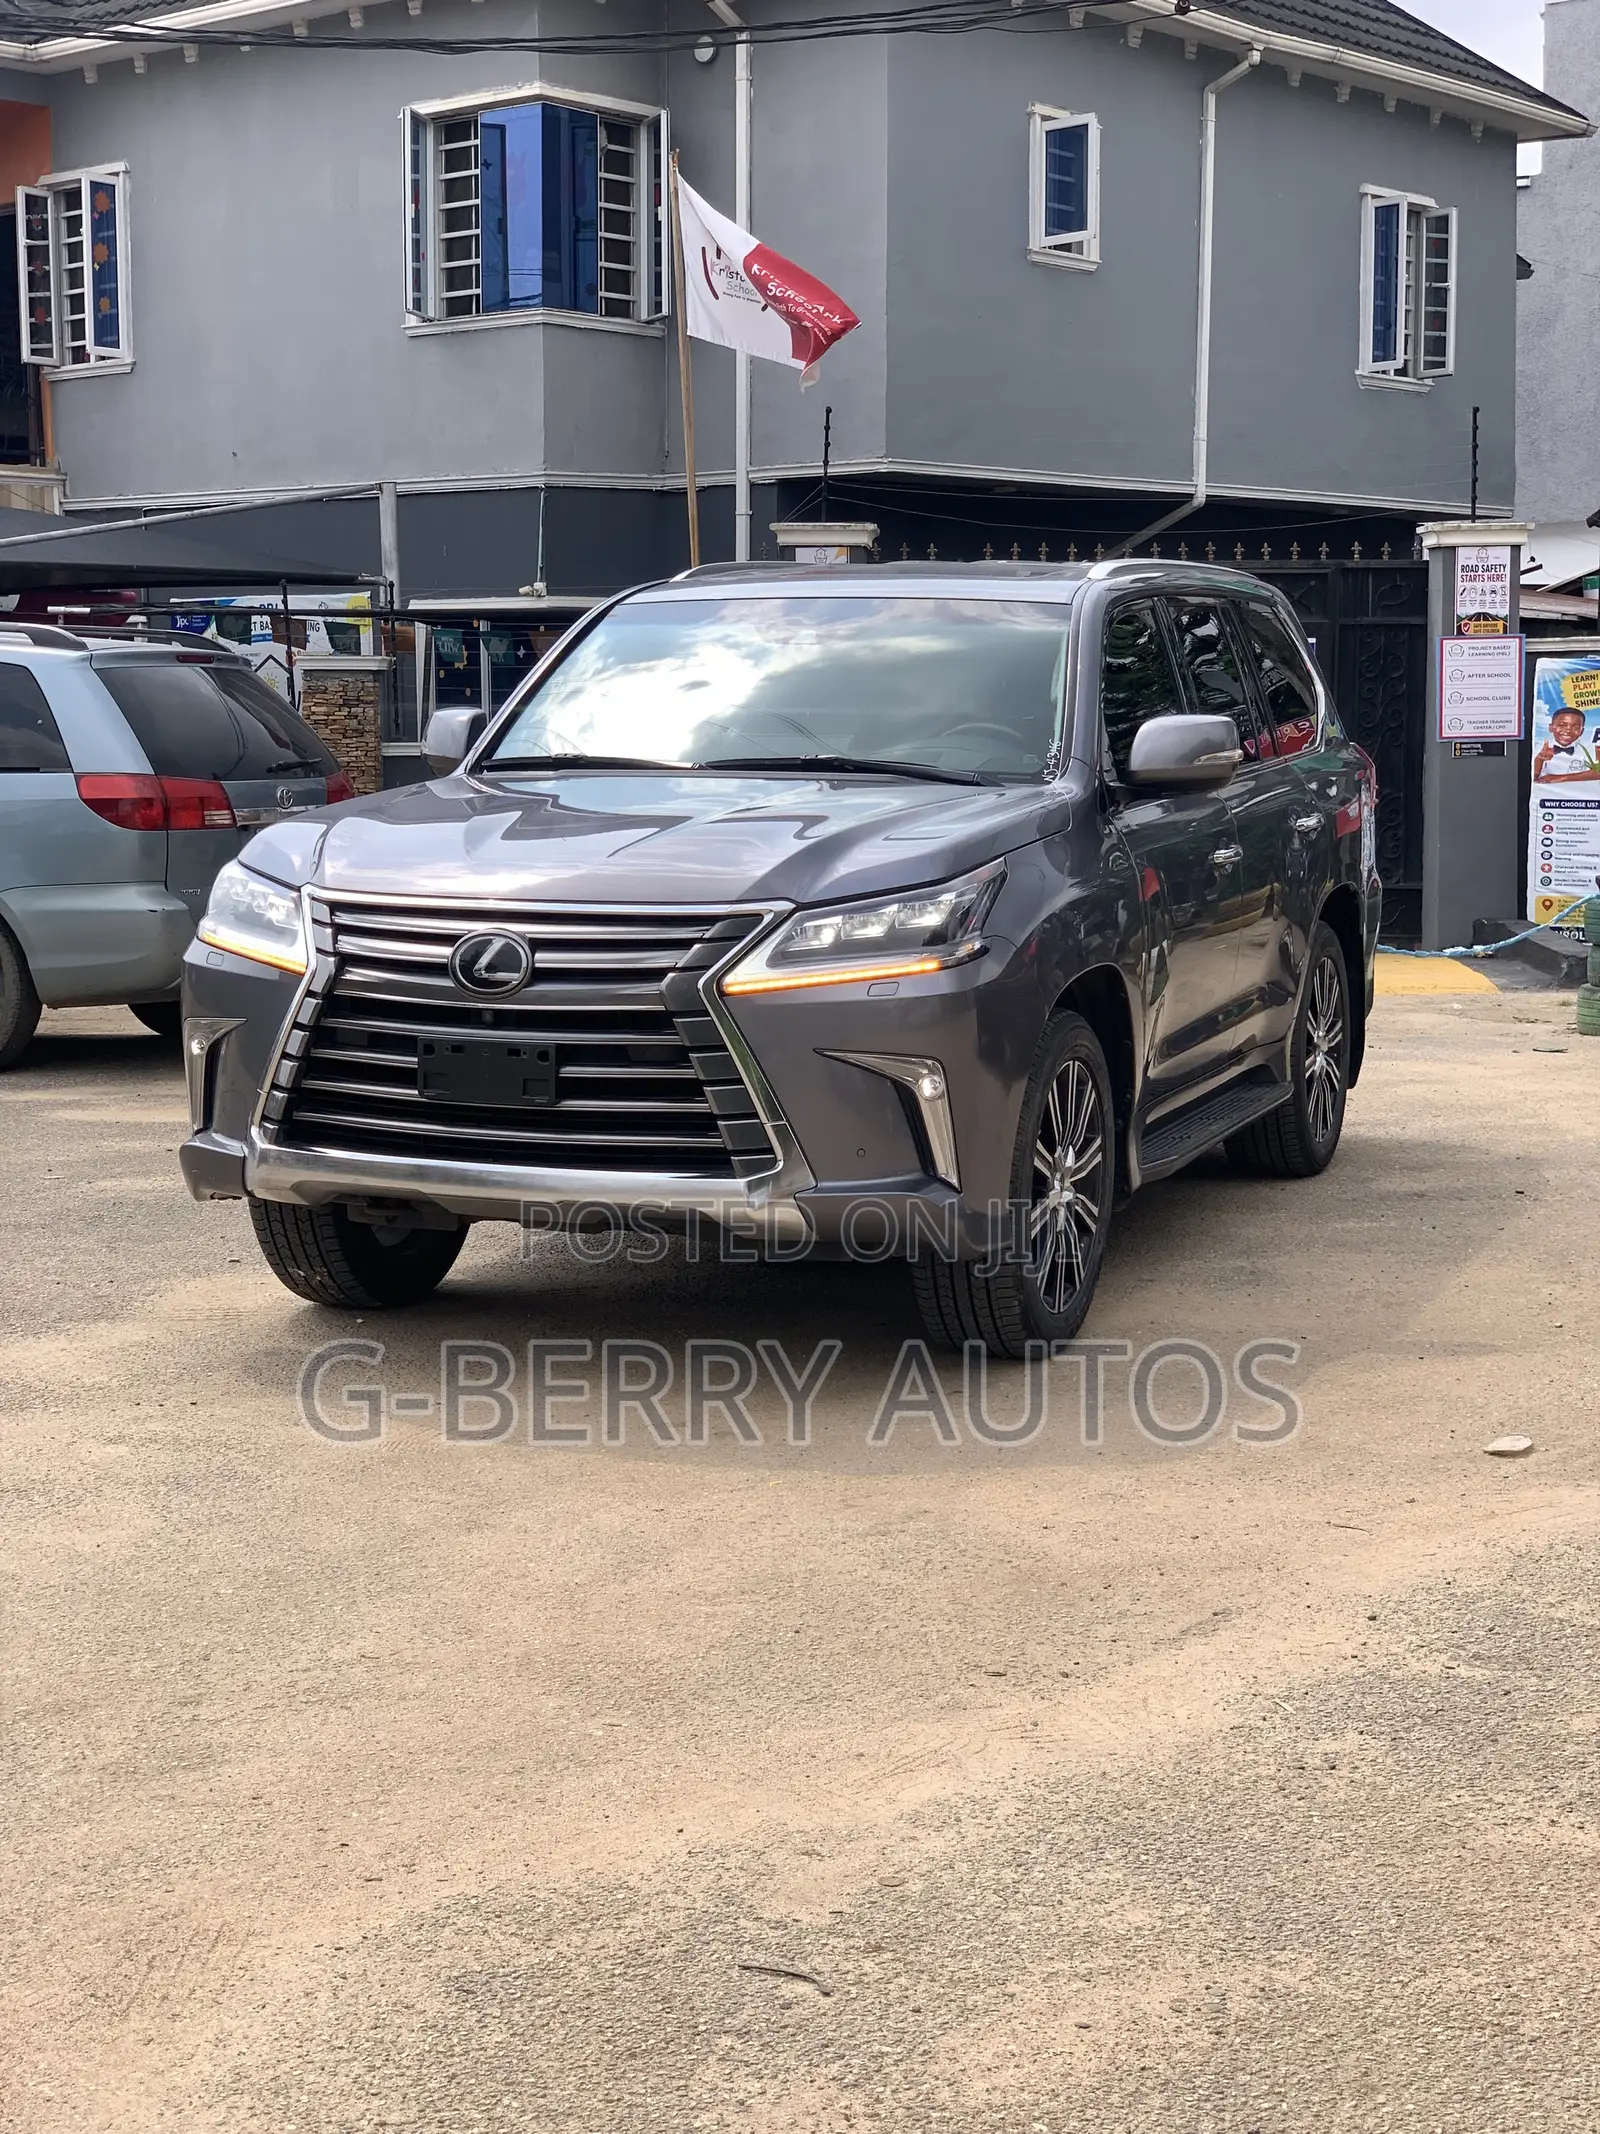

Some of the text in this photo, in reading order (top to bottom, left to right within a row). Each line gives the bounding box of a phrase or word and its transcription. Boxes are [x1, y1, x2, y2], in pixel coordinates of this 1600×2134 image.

[1460, 563, 1507, 573] ROAD SAFETY
[1460, 573, 1507, 583] STARTS HERE!
[1571, 674, 1599, 684] LEARN!
[1573, 681, 1596, 691] PLAY!
